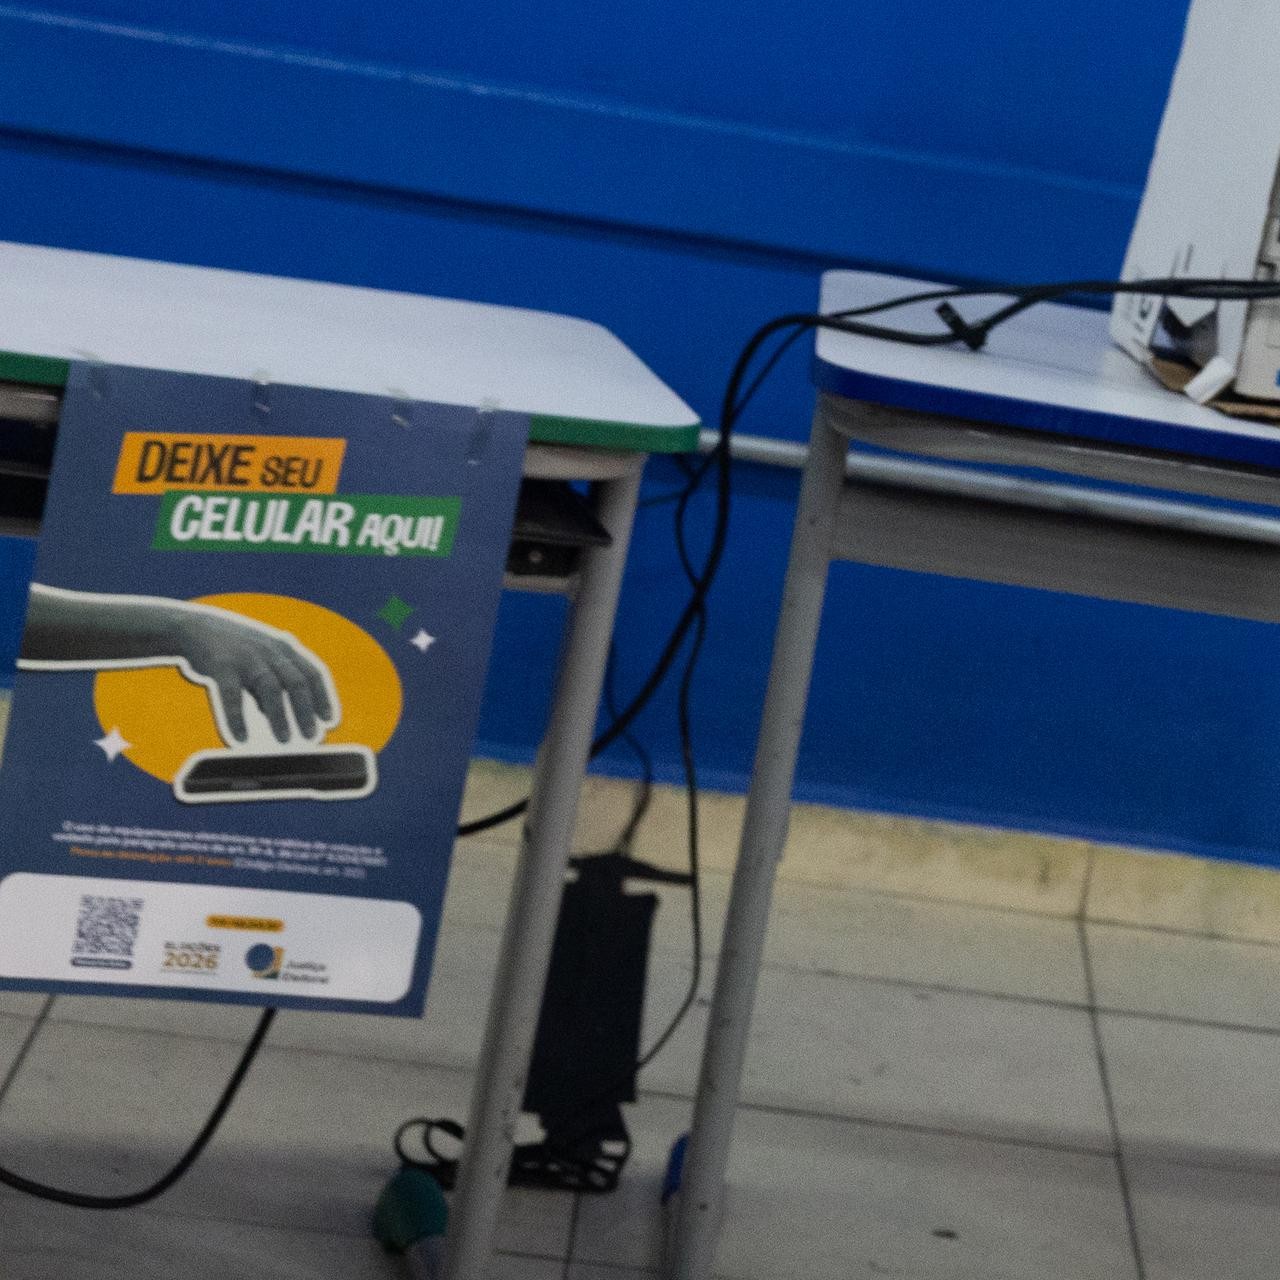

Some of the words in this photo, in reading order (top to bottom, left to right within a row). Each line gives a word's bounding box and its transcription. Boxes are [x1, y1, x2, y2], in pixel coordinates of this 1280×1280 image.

[135, 439, 256, 486] DEIXE
[259, 455, 323, 489] SEU
[169, 494, 356, 548] CELULAR
[356, 513, 446, 556] AQUI!
[162, 951, 219, 970] 2026
